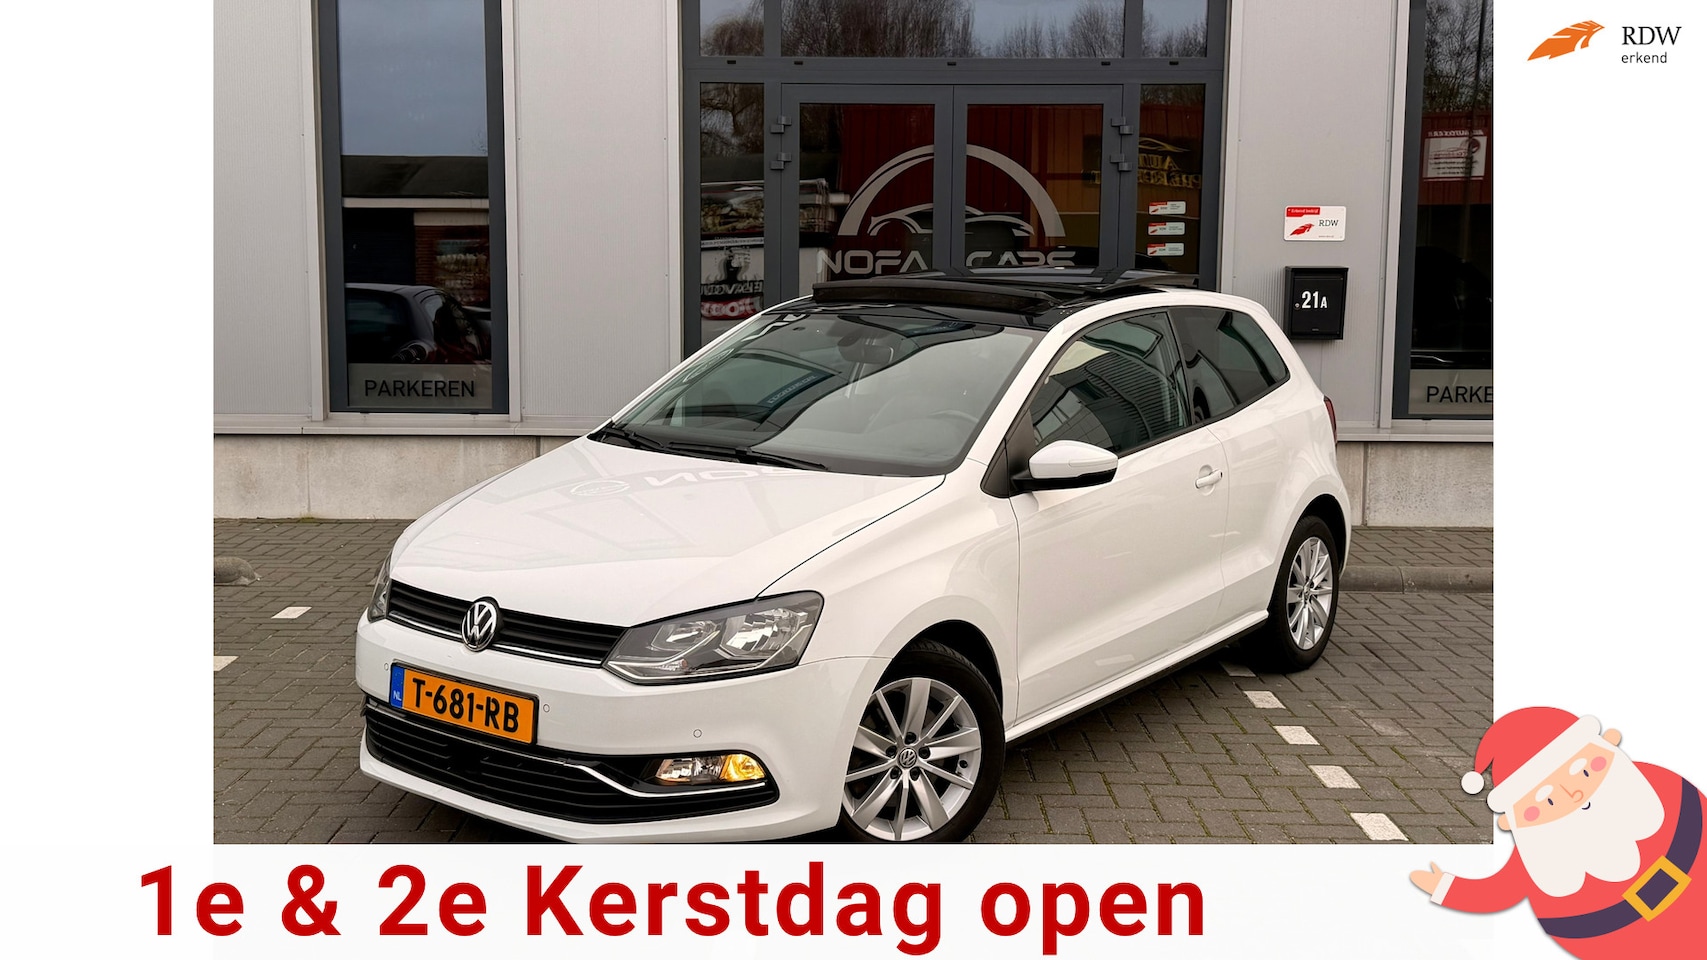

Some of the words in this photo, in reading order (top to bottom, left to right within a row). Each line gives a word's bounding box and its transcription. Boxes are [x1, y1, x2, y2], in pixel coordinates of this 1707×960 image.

[817, 250, 929, 275] NOFA
[1301, 290, 1328, 309] 21A
[364, 380, 475, 397] PARKEREN
[1426, 385, 1493, 403] PARKE
[392, 690, 402, 702] NL
[412, 677, 519, 733] T-681-RB
